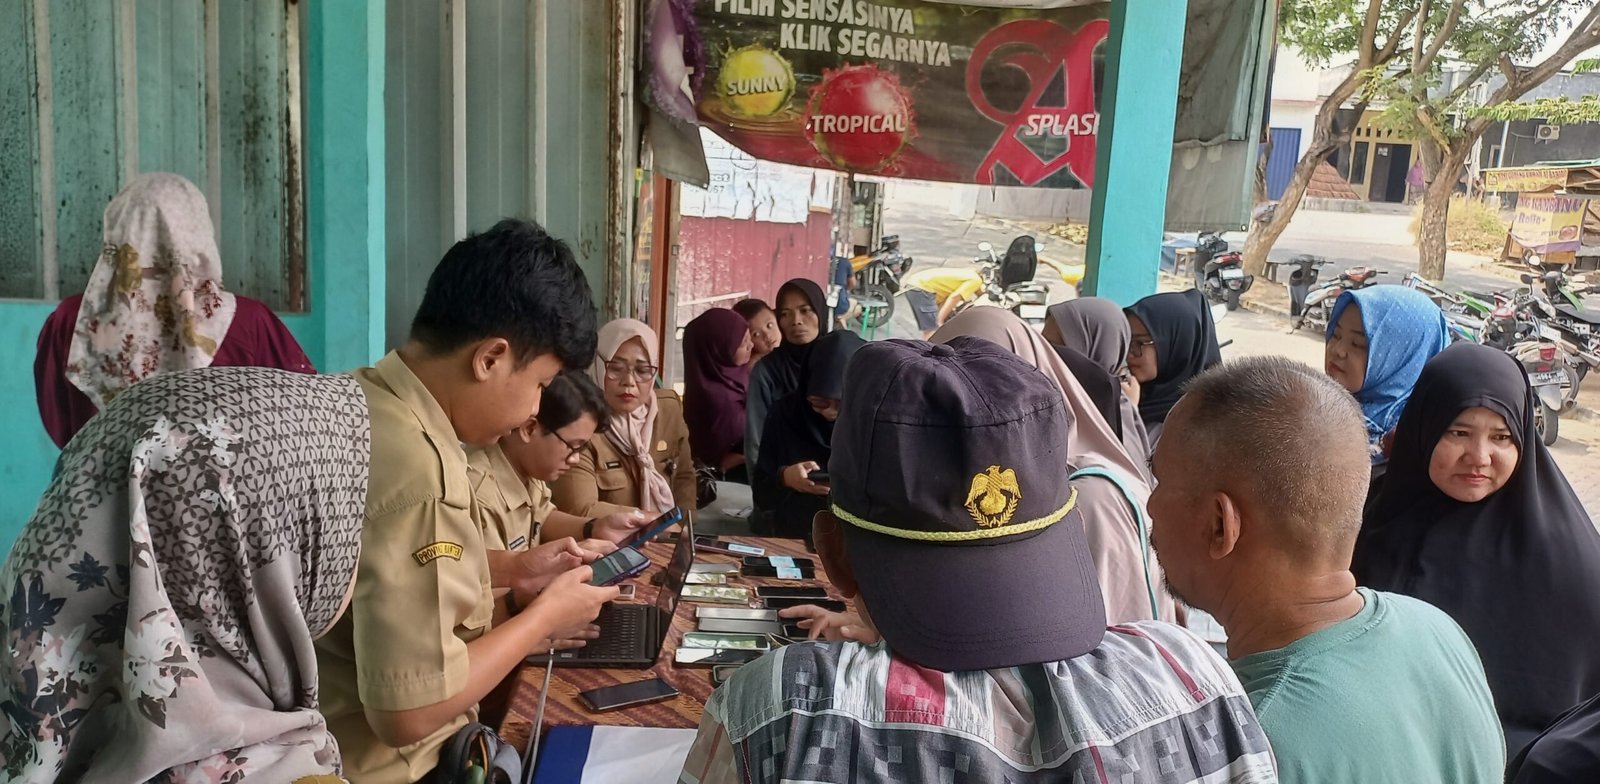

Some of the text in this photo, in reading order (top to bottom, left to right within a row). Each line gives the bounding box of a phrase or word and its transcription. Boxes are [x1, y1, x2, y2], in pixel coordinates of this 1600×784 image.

[714, 0, 915, 35] PILIH SENSASINYA
[780, 23, 951, 67] KLIK SEGARNYA
[727, 76, 787, 96] SUNNY
[811, 115, 906, 133] TROPICAL
